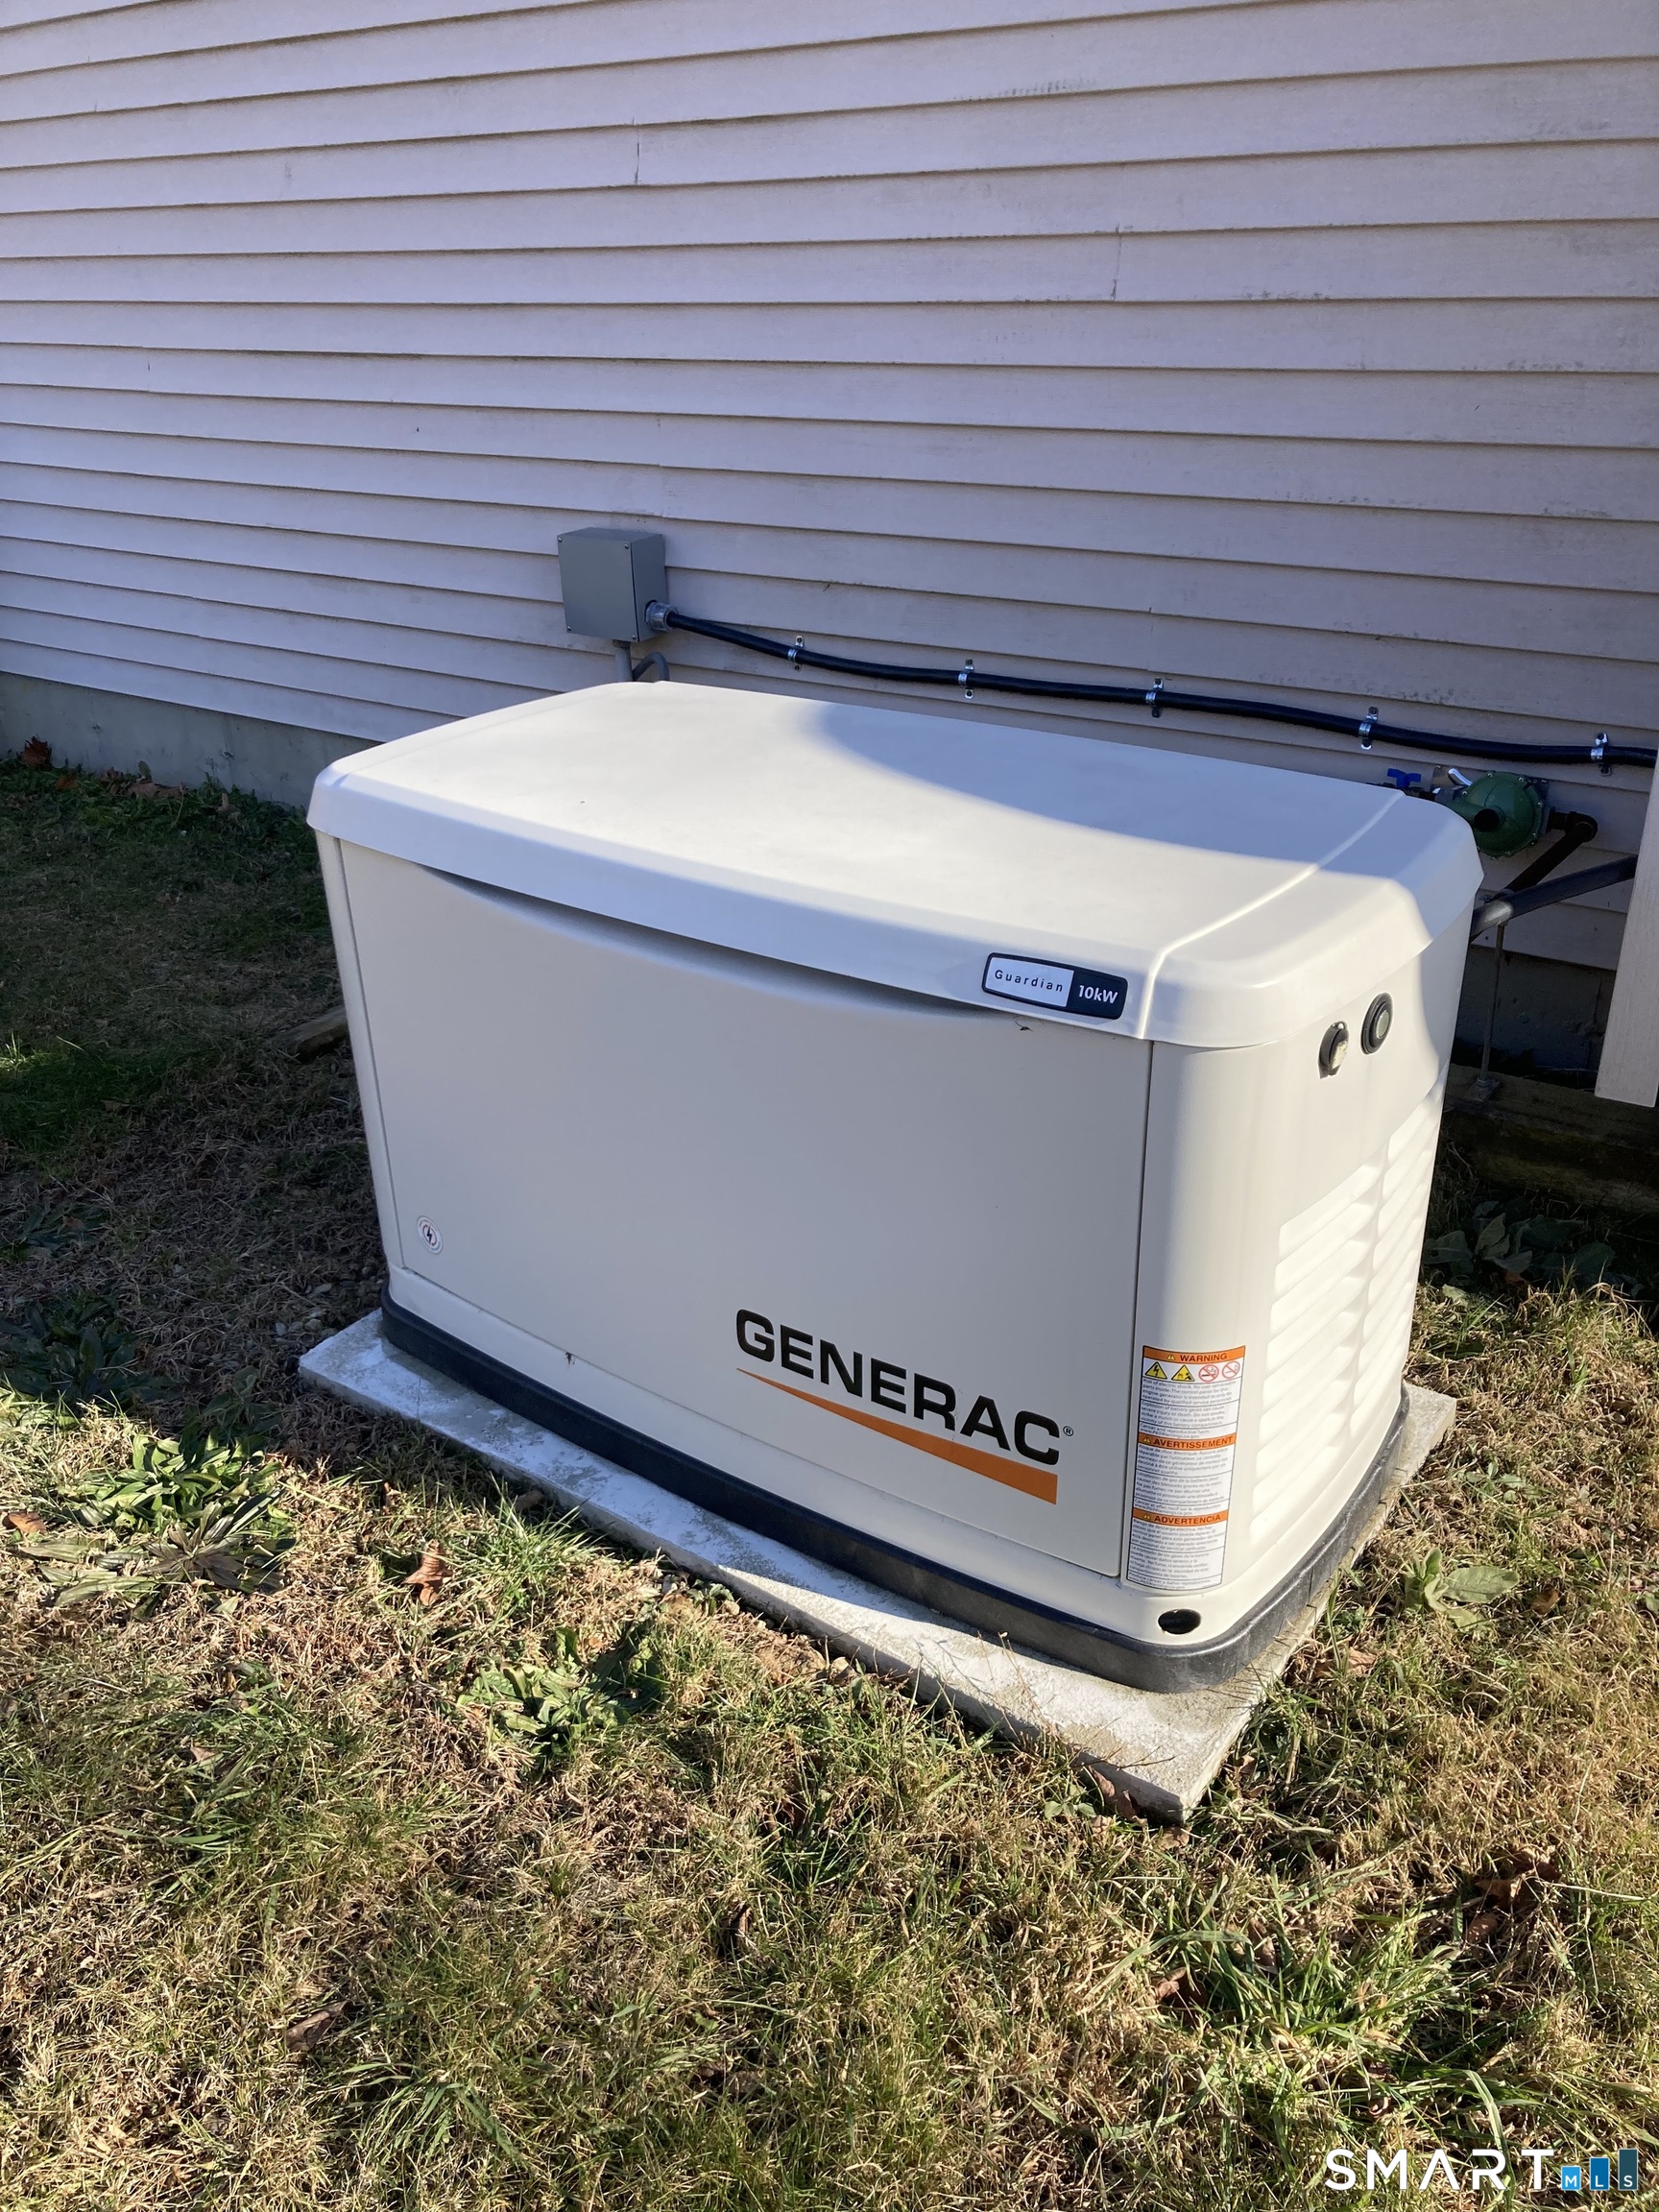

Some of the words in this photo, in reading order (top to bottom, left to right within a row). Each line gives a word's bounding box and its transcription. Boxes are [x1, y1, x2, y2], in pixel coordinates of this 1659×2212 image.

[995, 969, 1063, 993] Guardian
[1078, 984, 1118, 1004] 10kW
[1180, 1353, 1227, 1362] WARNING
[736, 1309, 1060, 1465] GENERAC
[1153, 1436, 1233, 1449] AVERTISSEMENT
[1154, 1514, 1221, 1525] ADVERTENCIA
